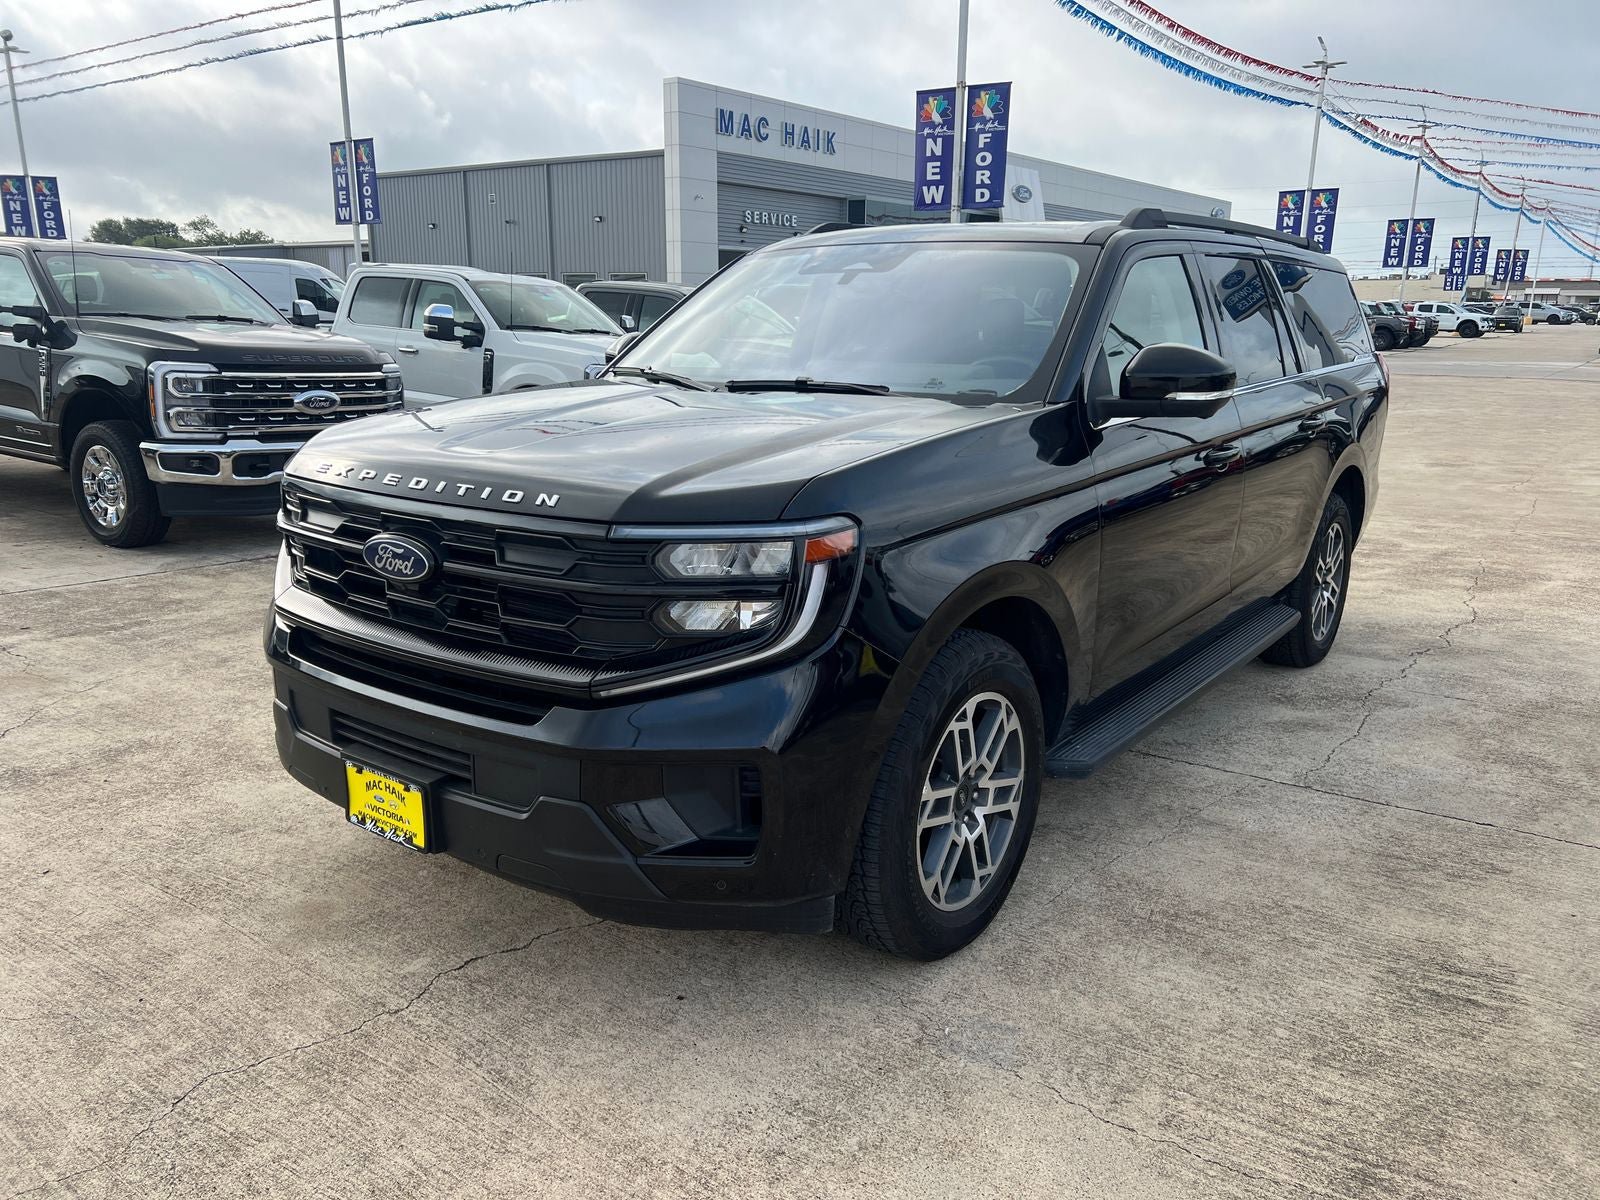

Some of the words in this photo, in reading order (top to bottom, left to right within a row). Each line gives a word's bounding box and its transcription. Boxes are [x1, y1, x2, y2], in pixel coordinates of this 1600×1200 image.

[718, 108, 769, 142] MAC
[782, 122, 836, 154] HAIK
[922, 137, 945, 205] NEW
[975, 133, 993, 203] FORD
[336, 174, 350, 220] NEW
[362, 173, 374, 221] FORD
[9, 200, 26, 237] NEW
[42, 201, 58, 237] FORD
[745, 209, 798, 227] SERVICE
[1314, 215, 1326, 249] FOR
[1387, 238, 1400, 266] NEW
[1413, 237, 1425, 266] FORD
[1452, 252, 1463, 274] NEW
[1473, 251, 1483, 274] FORD
[1496, 261, 1506, 280] NEW
[1514, 261, 1523, 281] FORD
[241, 354, 317, 363] SUPER
[319, 354, 365, 363] DUTY
[309, 396, 330, 408] Ford
[316, 463, 561, 508] EXPEDITION
[374, 542, 415, 576] Ford
[365, 779, 383, 792] MAC
[384, 781, 407, 807] HAIK
[370, 803, 404, 824] VICTORIA
[363, 819, 384, 837] Mac
[382, 828, 410, 846] Haik
